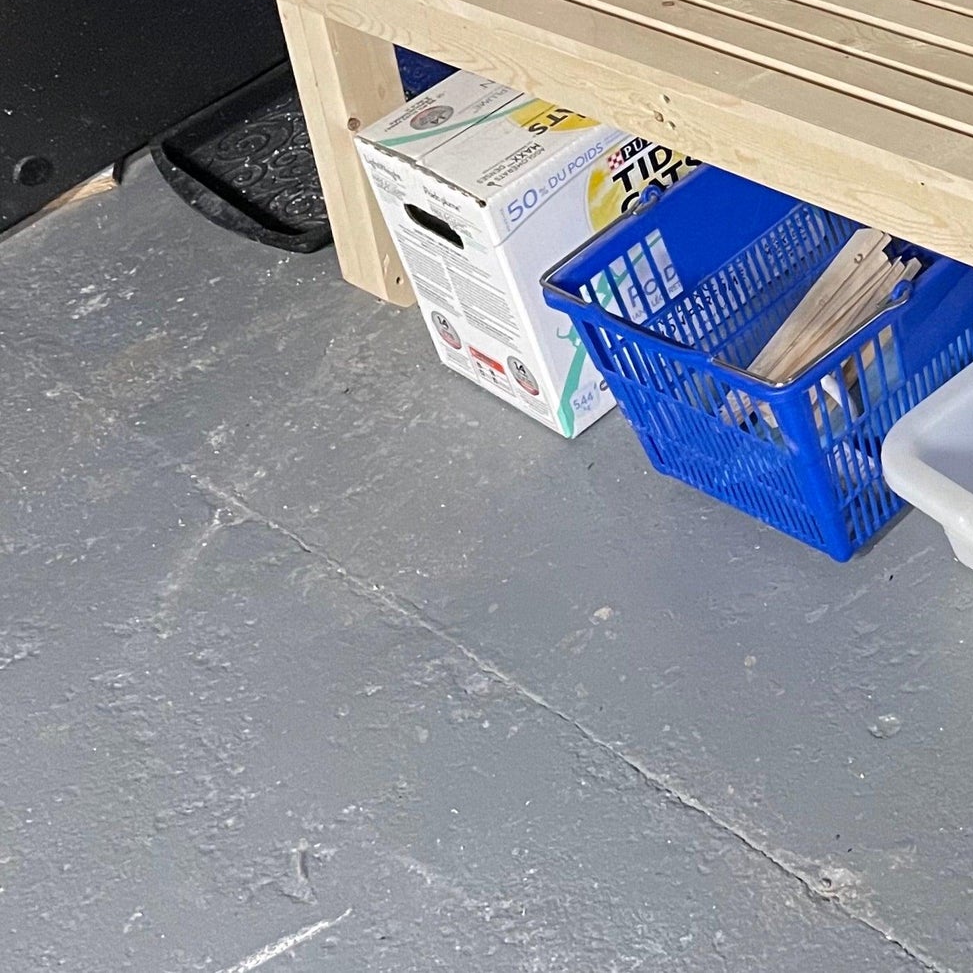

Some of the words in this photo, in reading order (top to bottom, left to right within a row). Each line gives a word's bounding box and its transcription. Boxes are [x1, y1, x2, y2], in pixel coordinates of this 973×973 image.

[547, 171, 567, 189] DU
[567, 142, 604, 175] POIDS
[612, 145, 673, 193] TID
